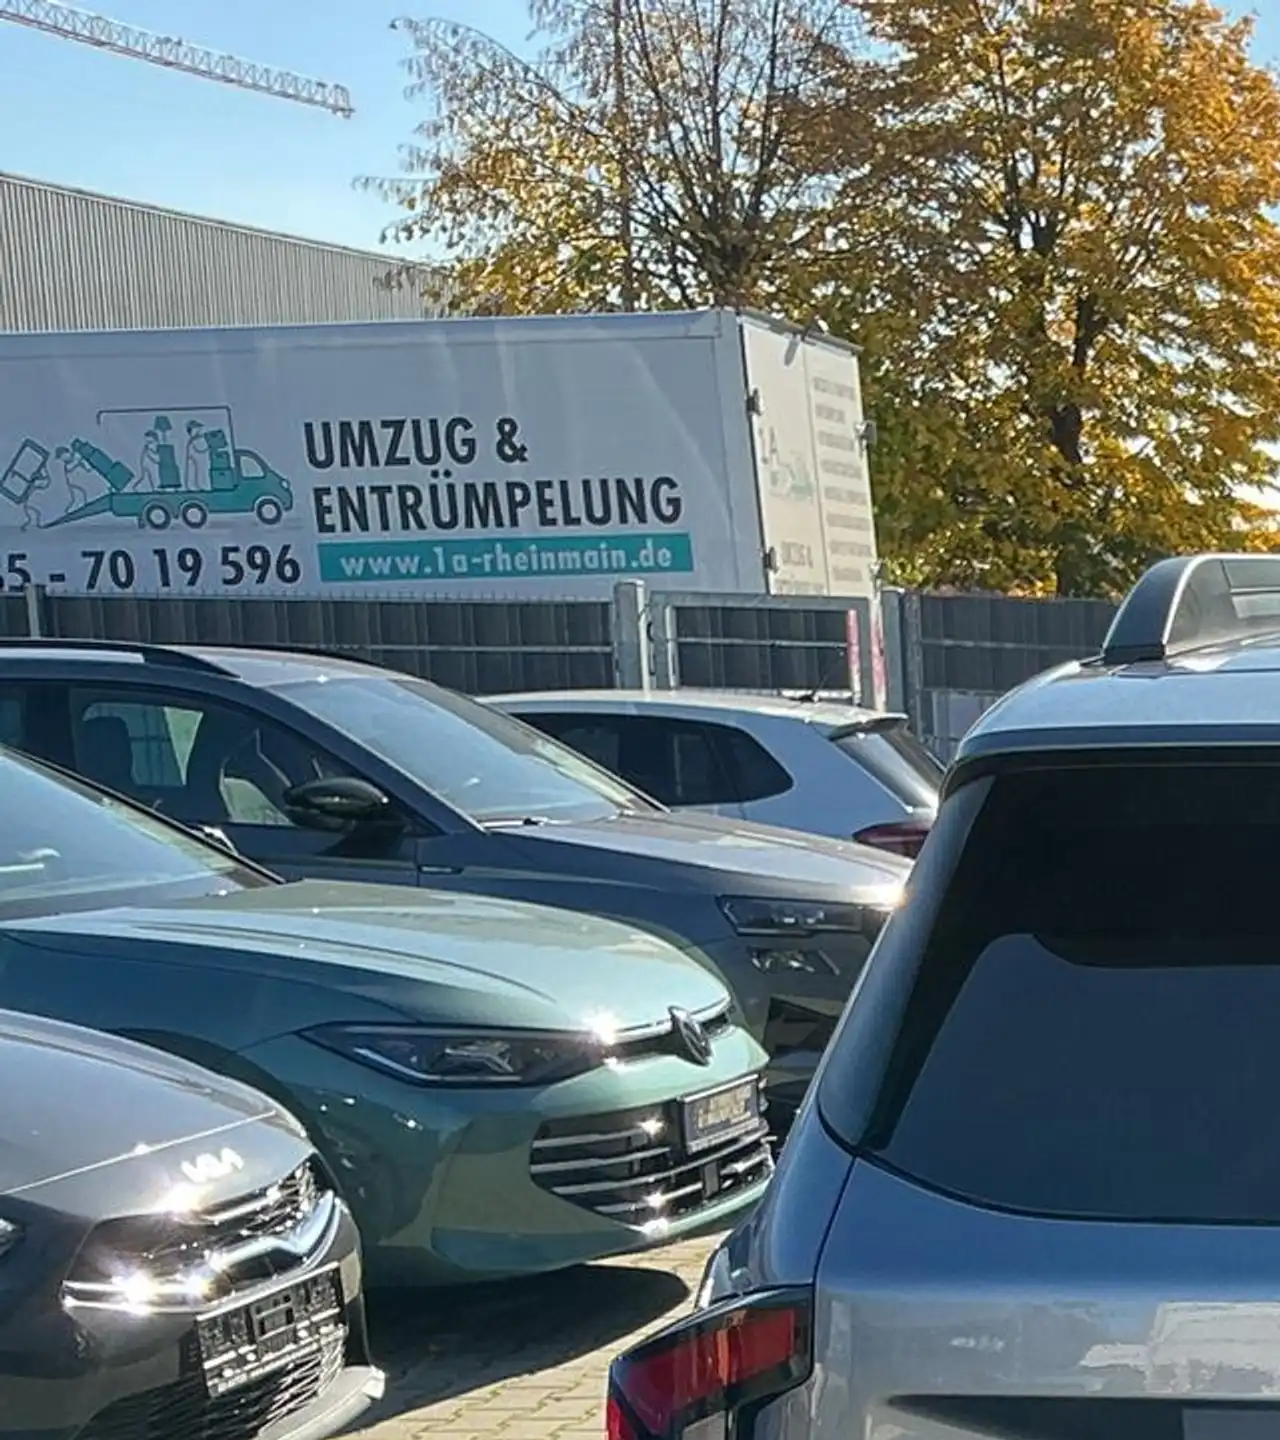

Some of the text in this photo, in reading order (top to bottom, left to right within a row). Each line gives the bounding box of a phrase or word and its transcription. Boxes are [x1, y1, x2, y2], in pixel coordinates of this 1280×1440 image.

[303, 416, 528, 469] UMZUG &
[312, 468, 684, 534] ENTRÜMPELUNG
[0, 553, 31, 592] 5
[81, 549, 135, 591] 70
[153, 547, 202, 587] 19
[220, 544, 301, 586] 596
[340, 539, 673, 578] www.1a-rheinmain.de
